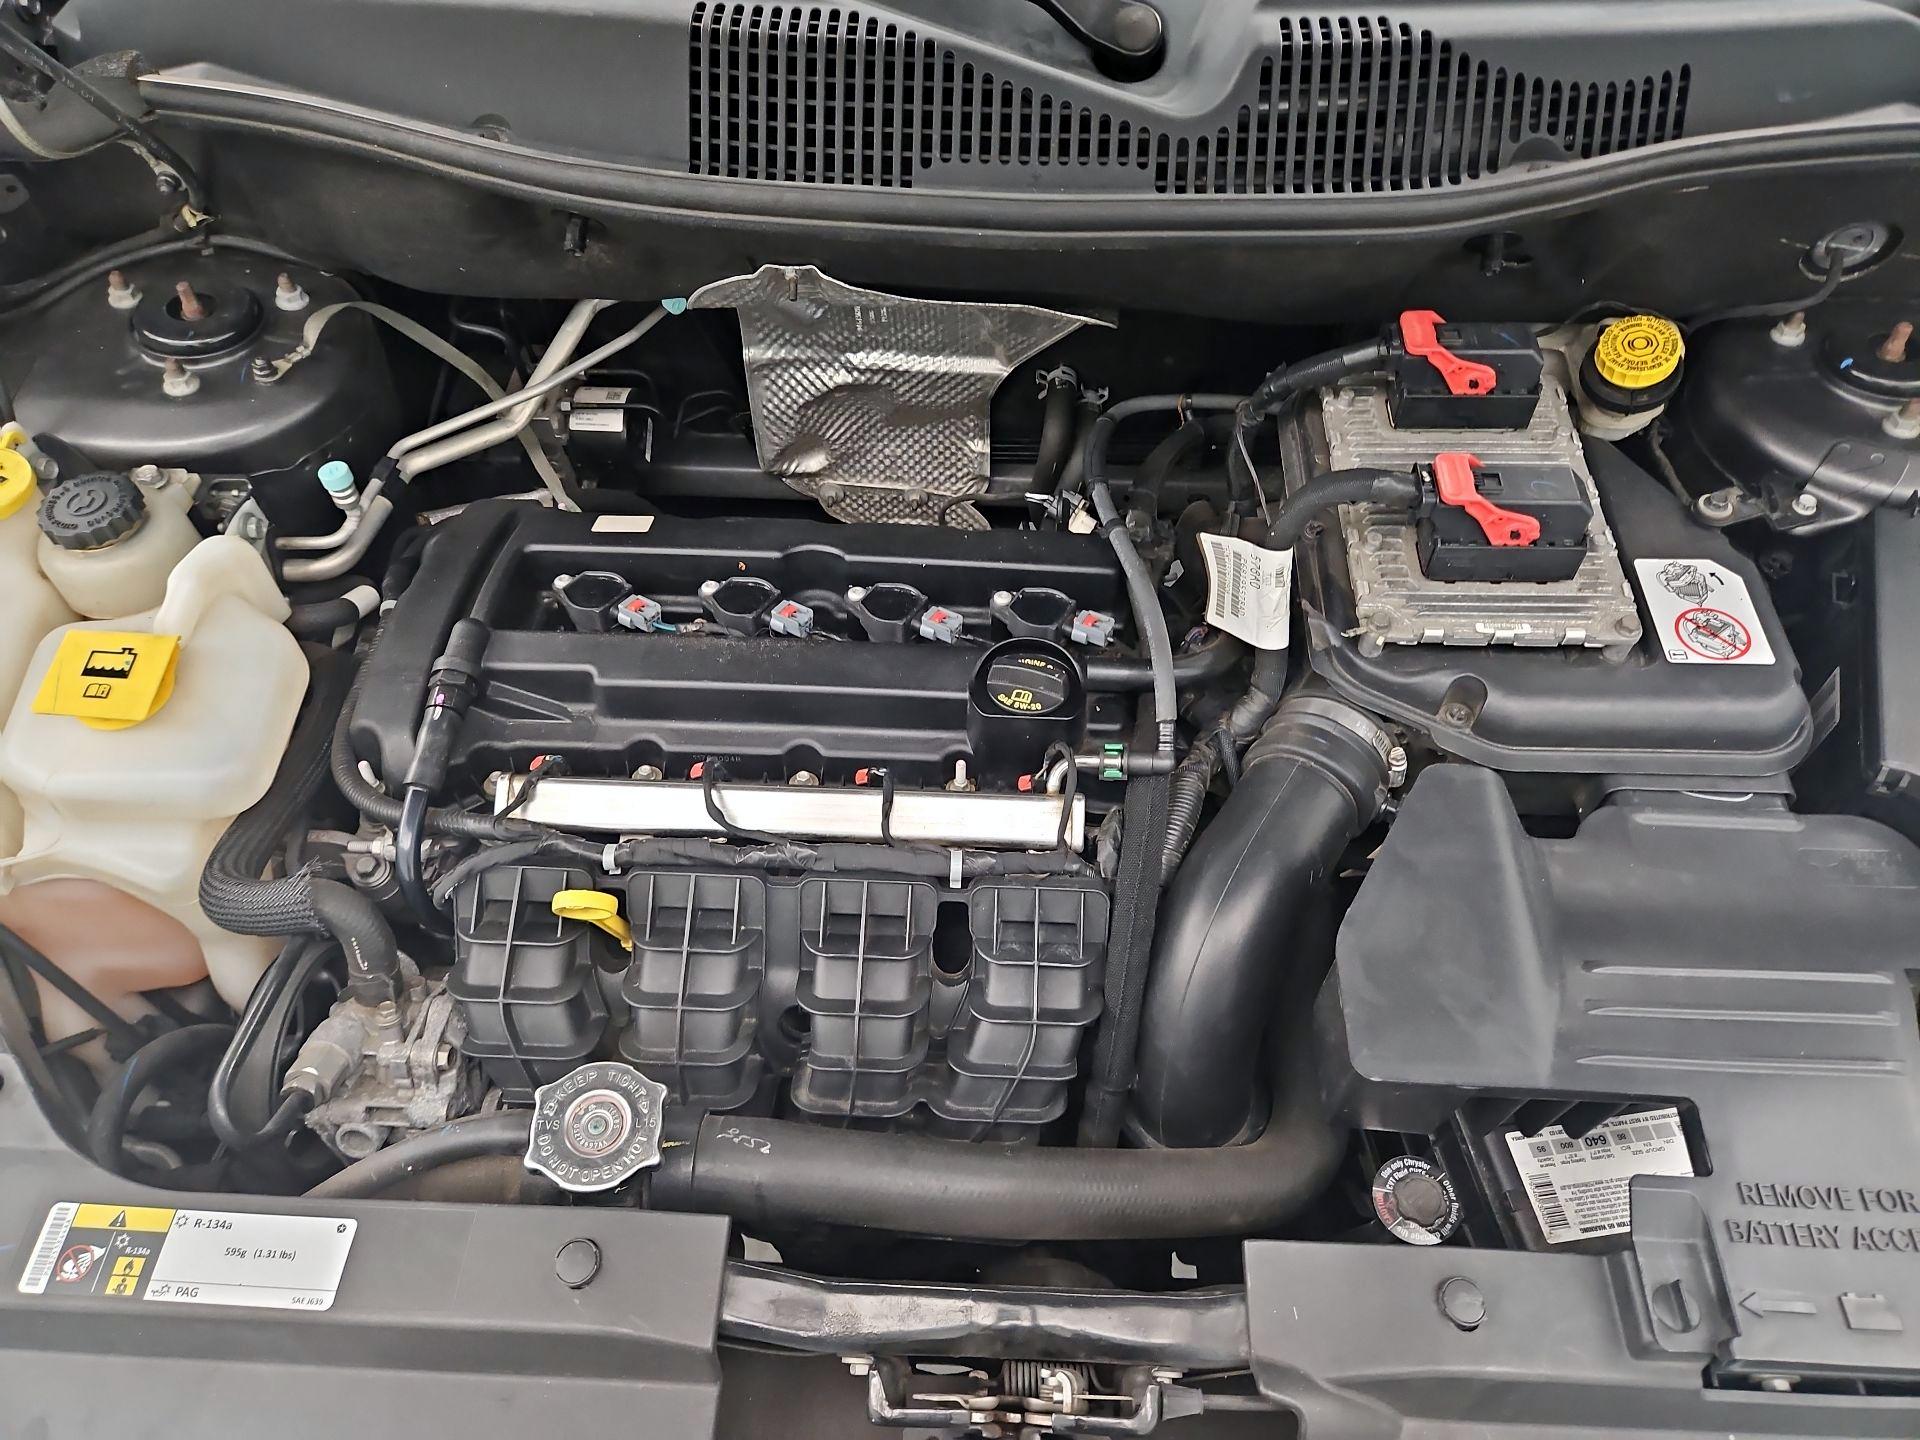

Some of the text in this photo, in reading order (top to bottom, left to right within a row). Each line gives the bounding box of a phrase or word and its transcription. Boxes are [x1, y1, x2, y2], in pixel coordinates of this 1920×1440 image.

[1250, 553, 1261, 590] 578AD
[998, 694, 1041, 710] SAE 5W-20
[556, 1070, 647, 1100] KEEP TIGHT
[537, 1120, 560, 1130] TVS
[1560, 1141, 1574, 1150] 800
[1584, 1134, 1607, 1147] 640
[1536, 1145, 1546, 1153] 95
[537, 1134, 648, 1182] DO NOT OPEN HOT
[1380, 1167, 1392, 1178] Use
[1404, 1158, 1431, 1170] Chrysler
[1386, 1177, 1397, 1191] CVT
[1442, 1180, 1456, 1201] Other
[1736, 1181, 1920, 1213] REMOVE FOR
[1448, 1202, 1459, 1223] fluids
[194, 1219, 232, 1230] R-134a
[1724, 1218, 1841, 1249] BATTERY
[224, 1248, 296, 1261] 595g (1.31 lbs)
[175, 1286, 199, 1298] PAG
